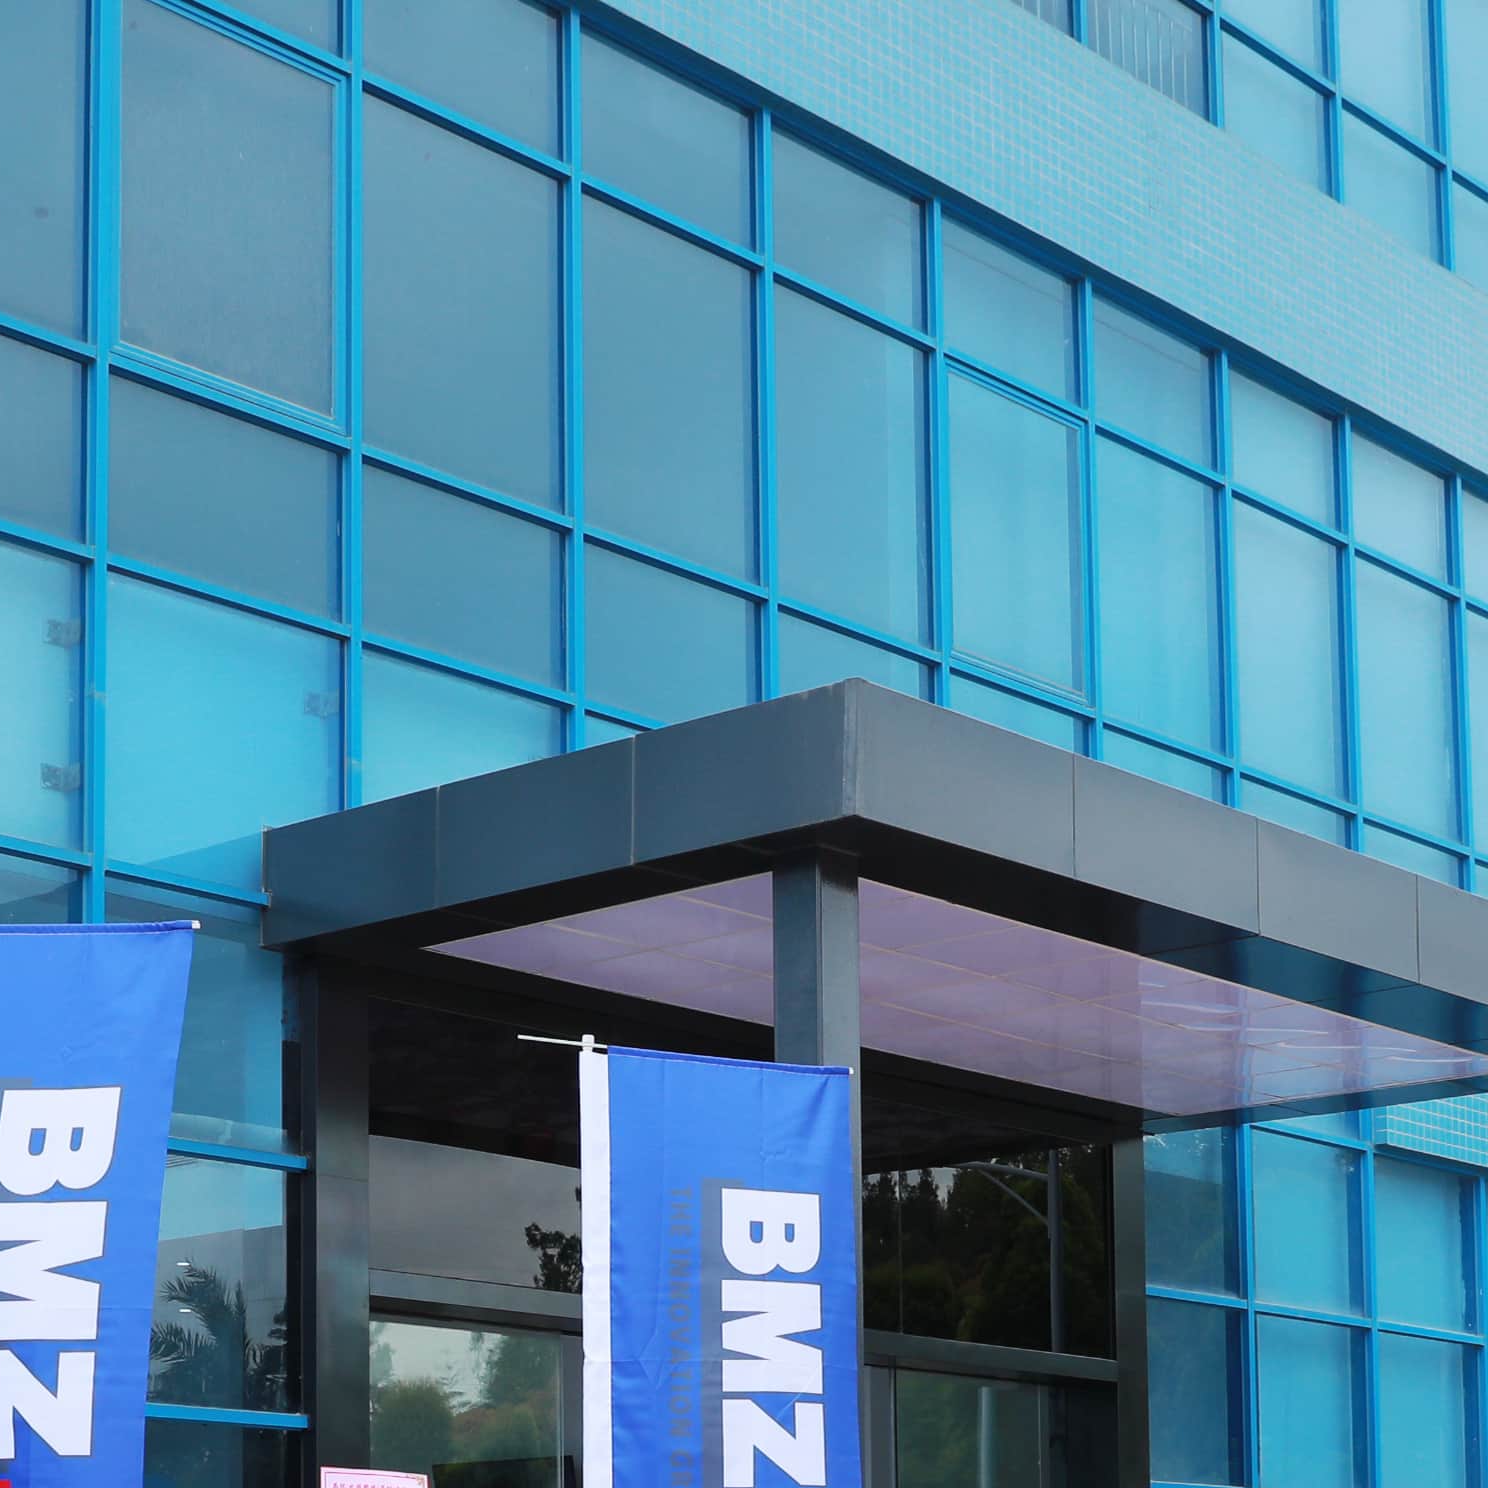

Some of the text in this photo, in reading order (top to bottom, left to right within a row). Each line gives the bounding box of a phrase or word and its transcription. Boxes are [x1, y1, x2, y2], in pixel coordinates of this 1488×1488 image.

[669, 1186, 694, 1239] THE
[668, 1248, 694, 1440] INNOVATION
[720, 1187, 827, 1488] BMZ
